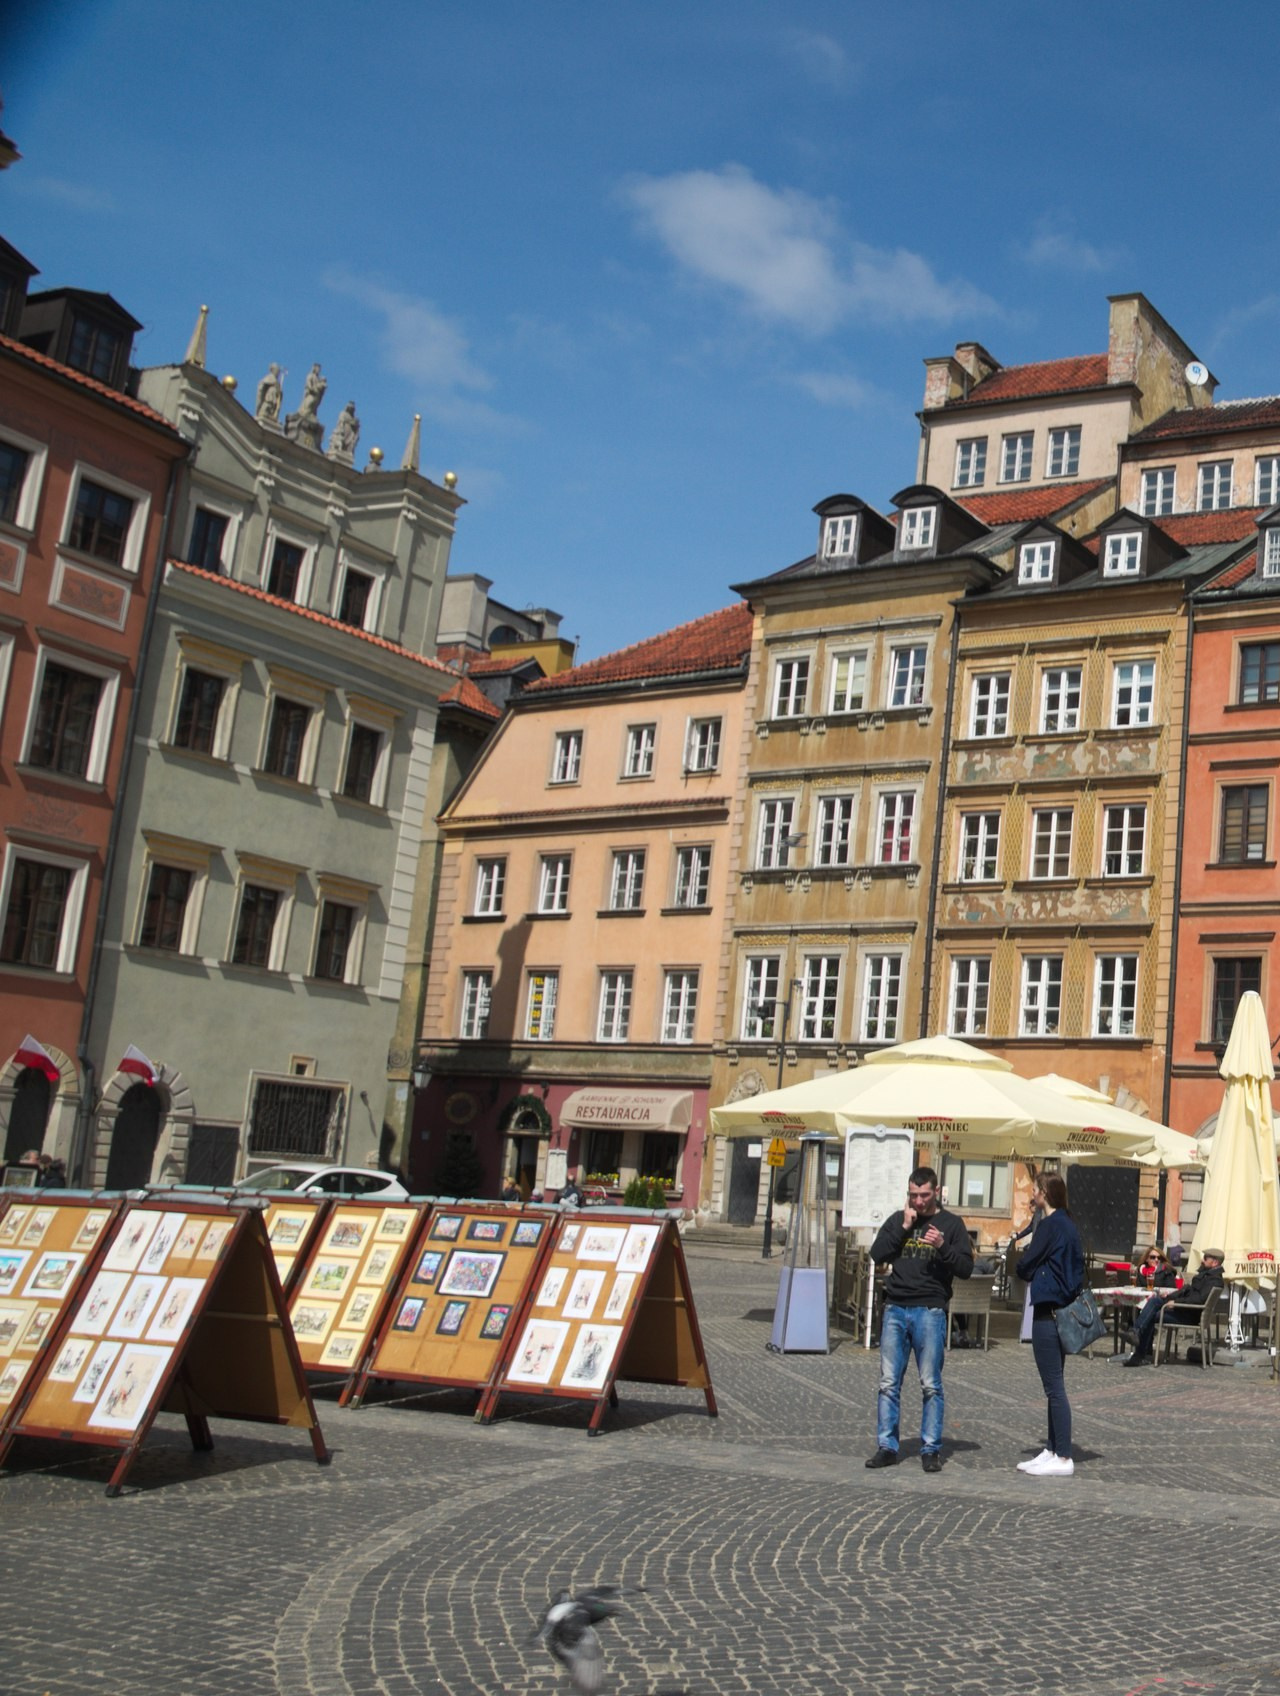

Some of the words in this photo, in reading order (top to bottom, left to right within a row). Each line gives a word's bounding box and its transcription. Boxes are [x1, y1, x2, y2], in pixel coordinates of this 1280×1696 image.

[575, 1105, 650, 1120] RESTAURACJA
[901, 1122, 969, 1132] ZWIERZYNIEC
[1066, 1132, 1111, 1145] ZWIERZYNIEC
